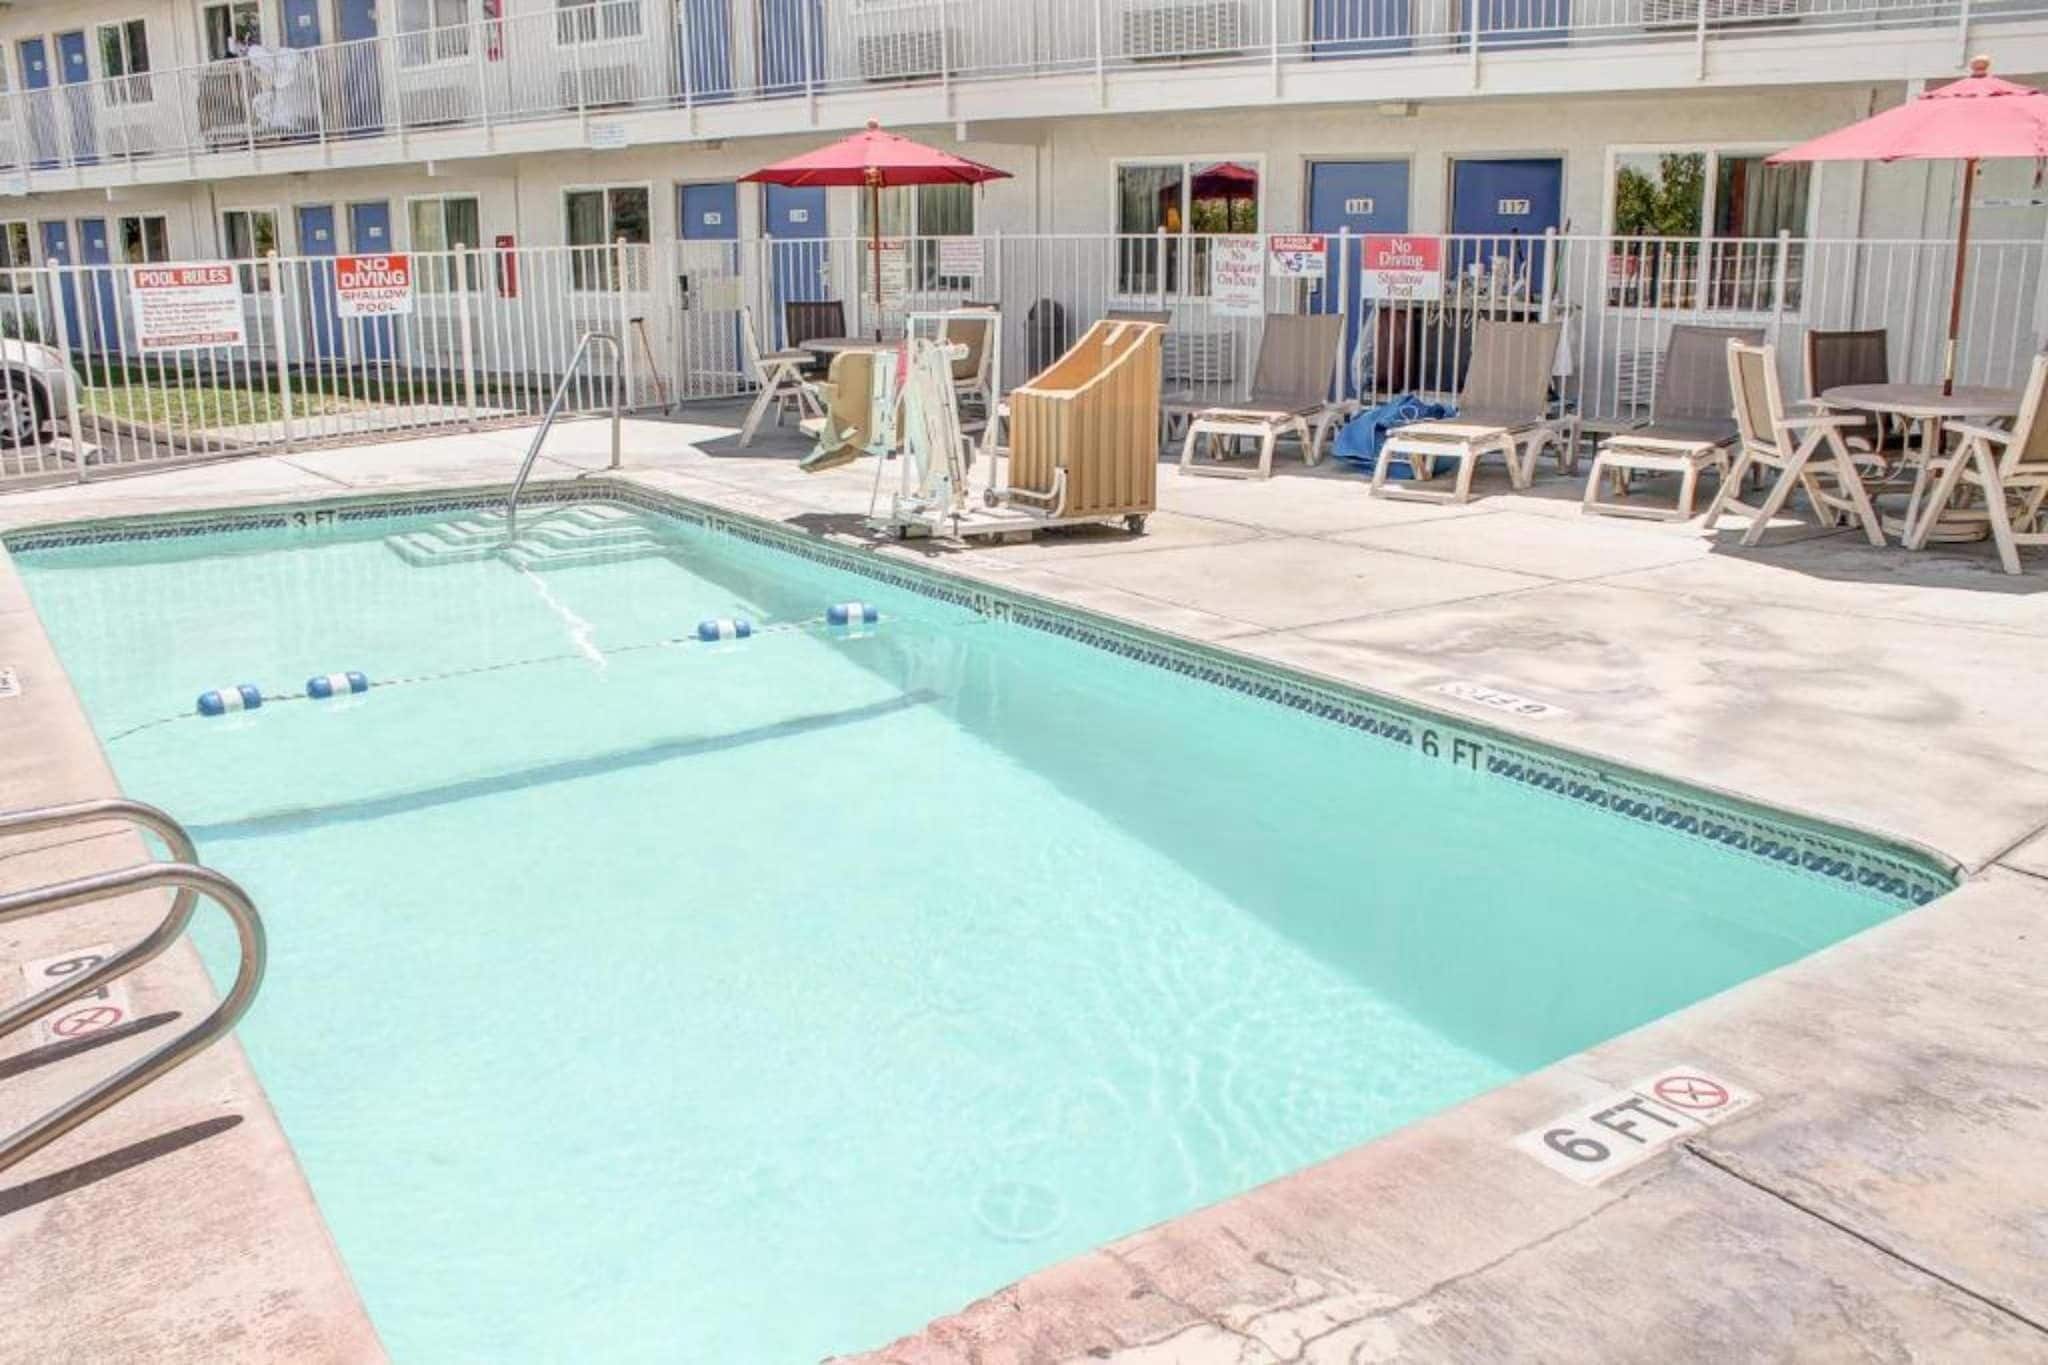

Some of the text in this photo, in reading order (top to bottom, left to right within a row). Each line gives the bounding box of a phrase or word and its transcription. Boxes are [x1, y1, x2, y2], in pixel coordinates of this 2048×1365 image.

[1391, 239, 1413, 254] No
[355, 258, 390, 271] NO
[1379, 251, 1424, 270] Diving
[139, 267, 228, 288] POOL RULES
[341, 269, 406, 288] DIVING
[342, 289, 407, 300] SHALLOW
[355, 302, 397, 313] POOL
[315, 509, 336, 525] FT
[1421, 729, 1483, 771] 6 FT
[1543, 1128, 1611, 1163] 6
[1590, 1097, 1679, 1144] FT
